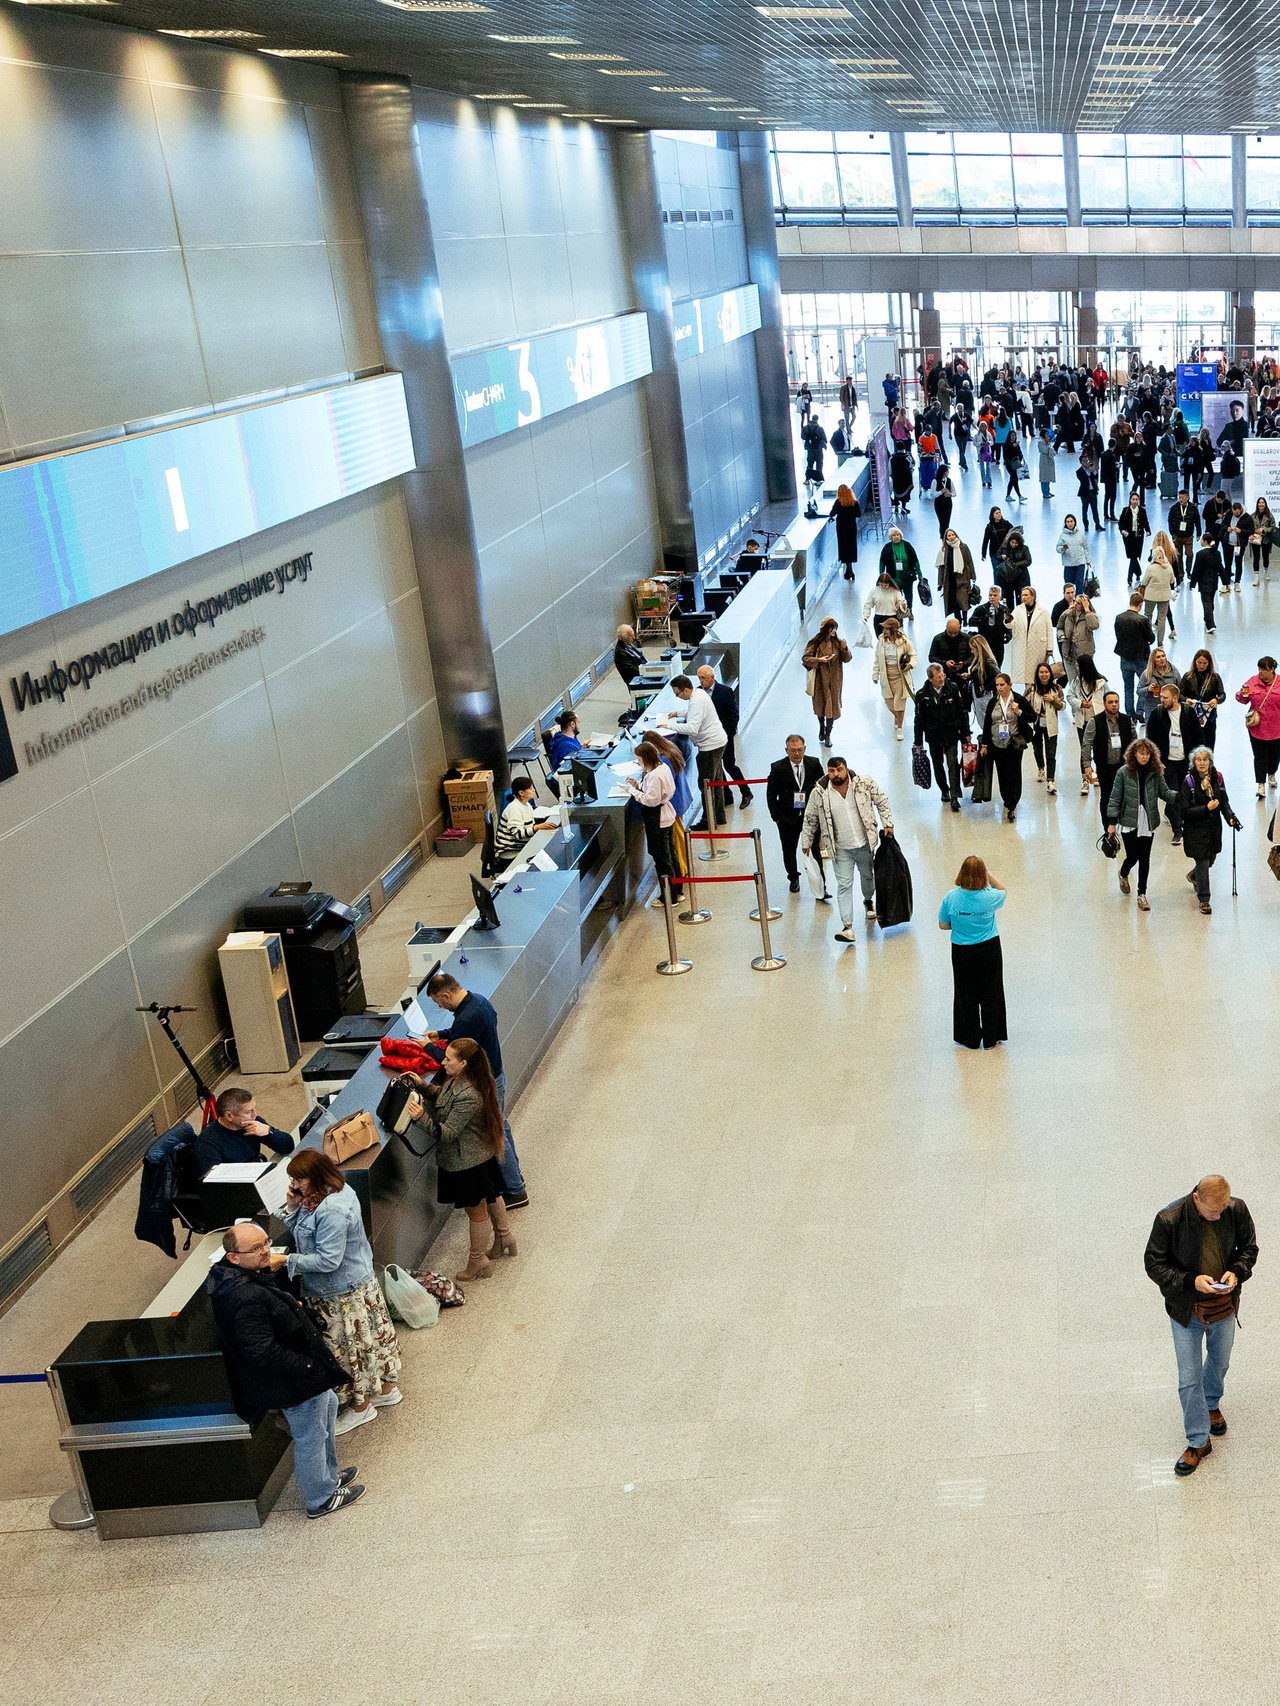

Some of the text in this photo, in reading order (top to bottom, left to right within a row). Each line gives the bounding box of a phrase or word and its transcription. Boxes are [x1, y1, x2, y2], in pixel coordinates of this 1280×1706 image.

[508, 341, 541, 427] 3
[12, 551, 314, 712] Информация и оформление услуг
[24, 625, 266, 768] Information and registration services
[450, 794, 477, 802] СДАЙ
[451, 804, 487, 812] БУМАГУ
